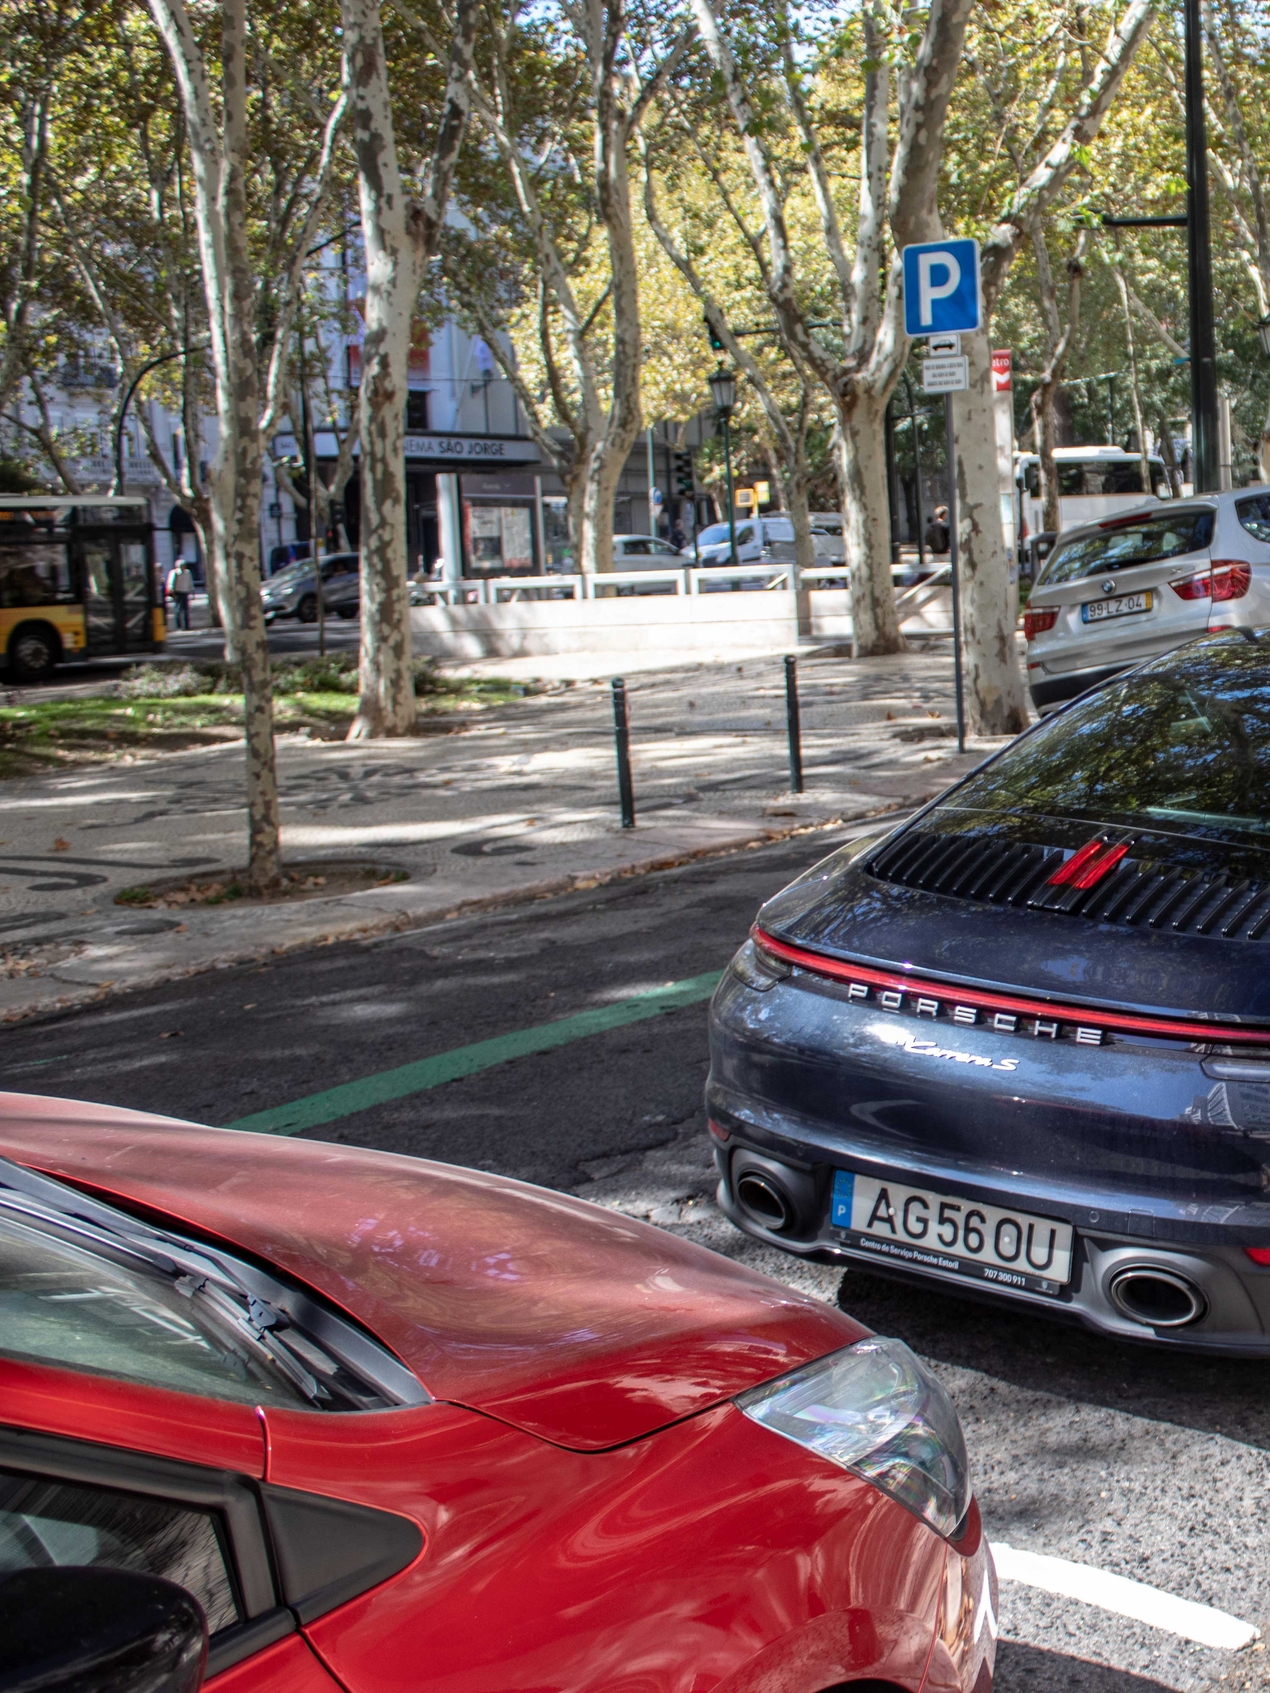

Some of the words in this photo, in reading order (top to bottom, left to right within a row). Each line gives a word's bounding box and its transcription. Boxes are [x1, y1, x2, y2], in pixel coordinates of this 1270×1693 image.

[918, 251, 961, 326] P
[991, 357, 1010, 367] etro
[404, 439, 434, 453] NEMA
[438, 438, 464, 454] SÃO
[468, 441, 506, 455] JORGE
[848, 983, 1102, 1046] PORSCHE
[904, 1041, 993, 1067] Carrera
[992, 1058, 1020, 1071] S
[837, 1204, 847, 1217] P
[860, 1237, 882, 1251] Centro
[881, 1243, 890, 1253] de
[889, 1245, 914, 1259] Serviço
[913, 1250, 938, 1264] Porsche
[938, 1257, 959, 1270] Estoril
[984, 1267, 998, 1279] 707
[998, 1272, 1012, 1283] 300
[1012, 1275, 1026, 1287] 911
